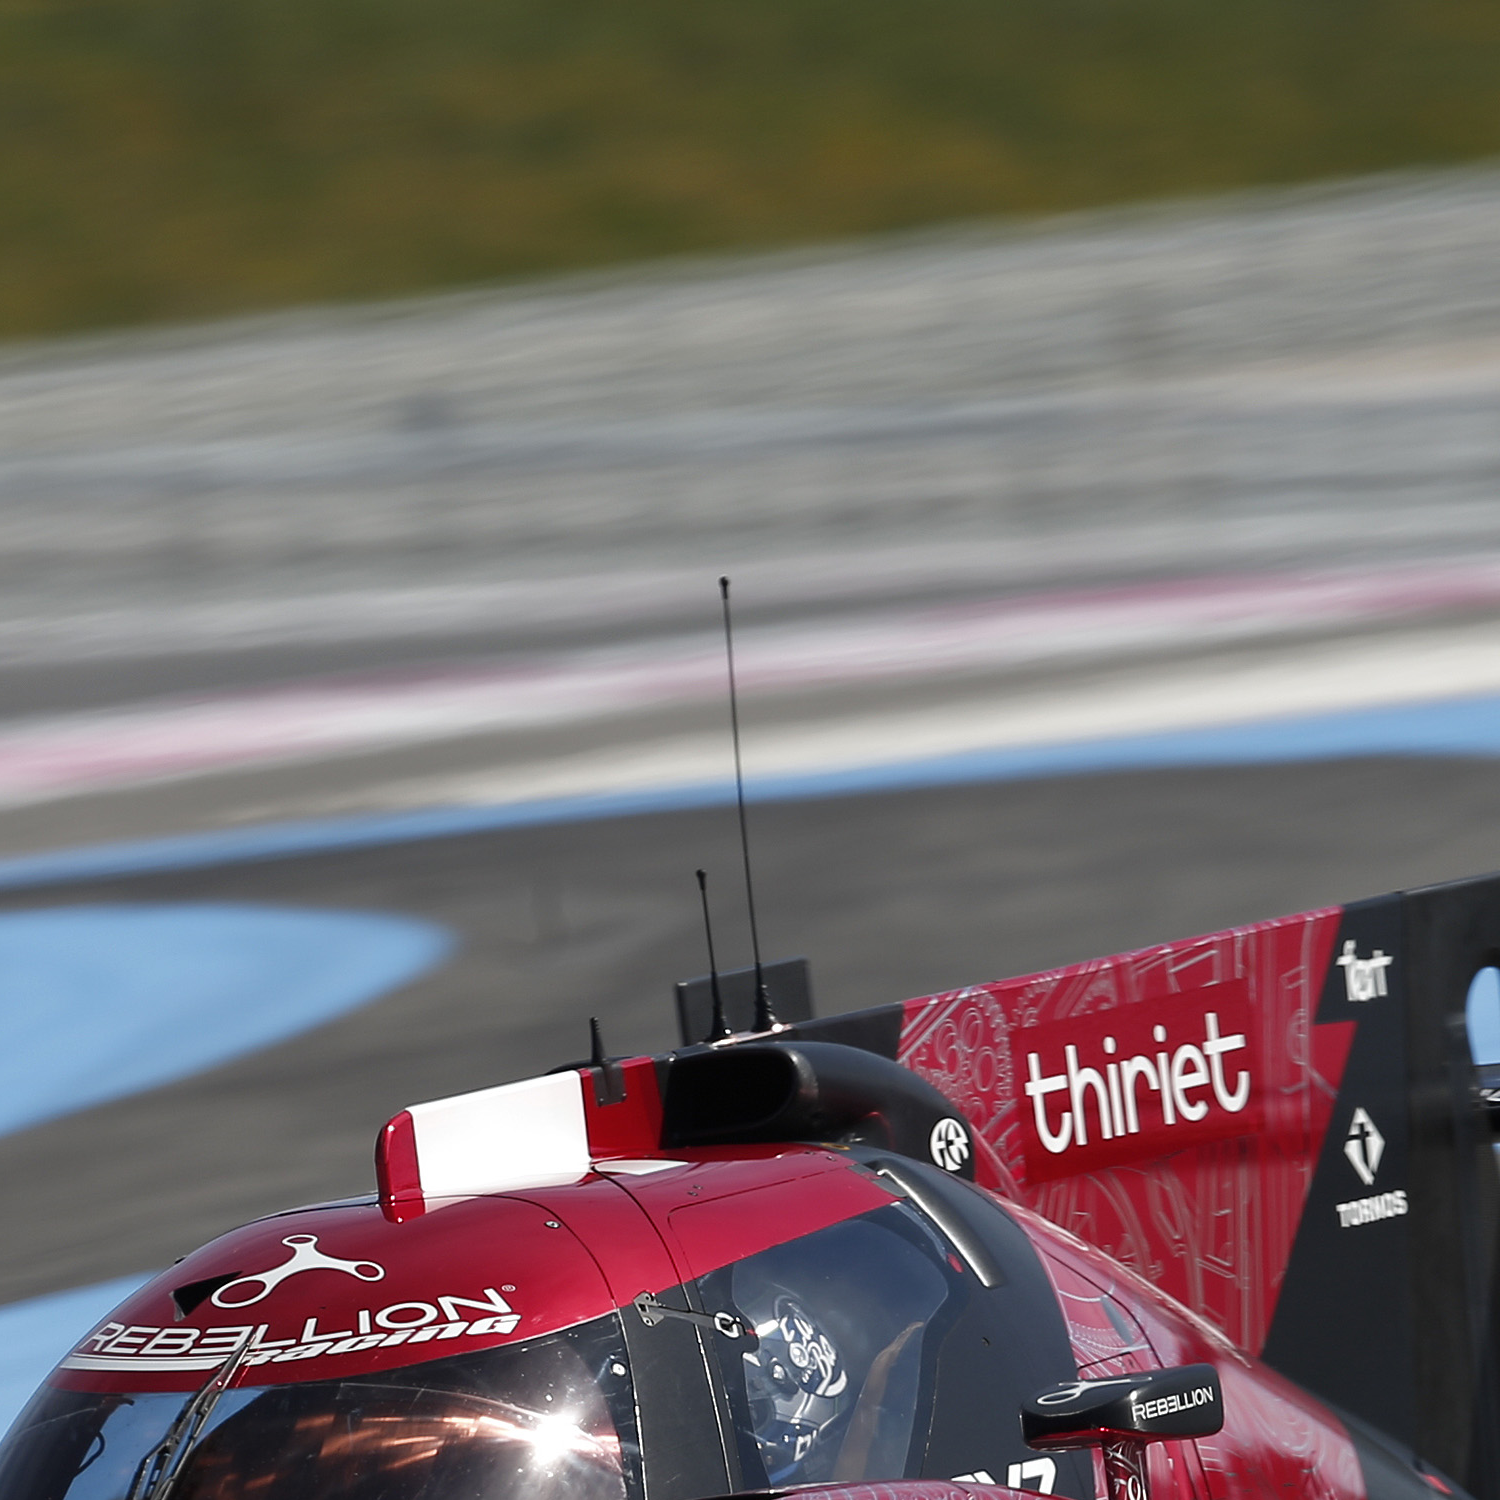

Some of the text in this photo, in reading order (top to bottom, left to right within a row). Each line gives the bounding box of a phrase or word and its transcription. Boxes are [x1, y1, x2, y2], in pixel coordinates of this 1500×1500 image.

[1025, 1012, 1249, 1153] thiriet
[77, 1288, 514, 1354] REBELLION
[1132, 1386, 1214, 1422] REBELLION
